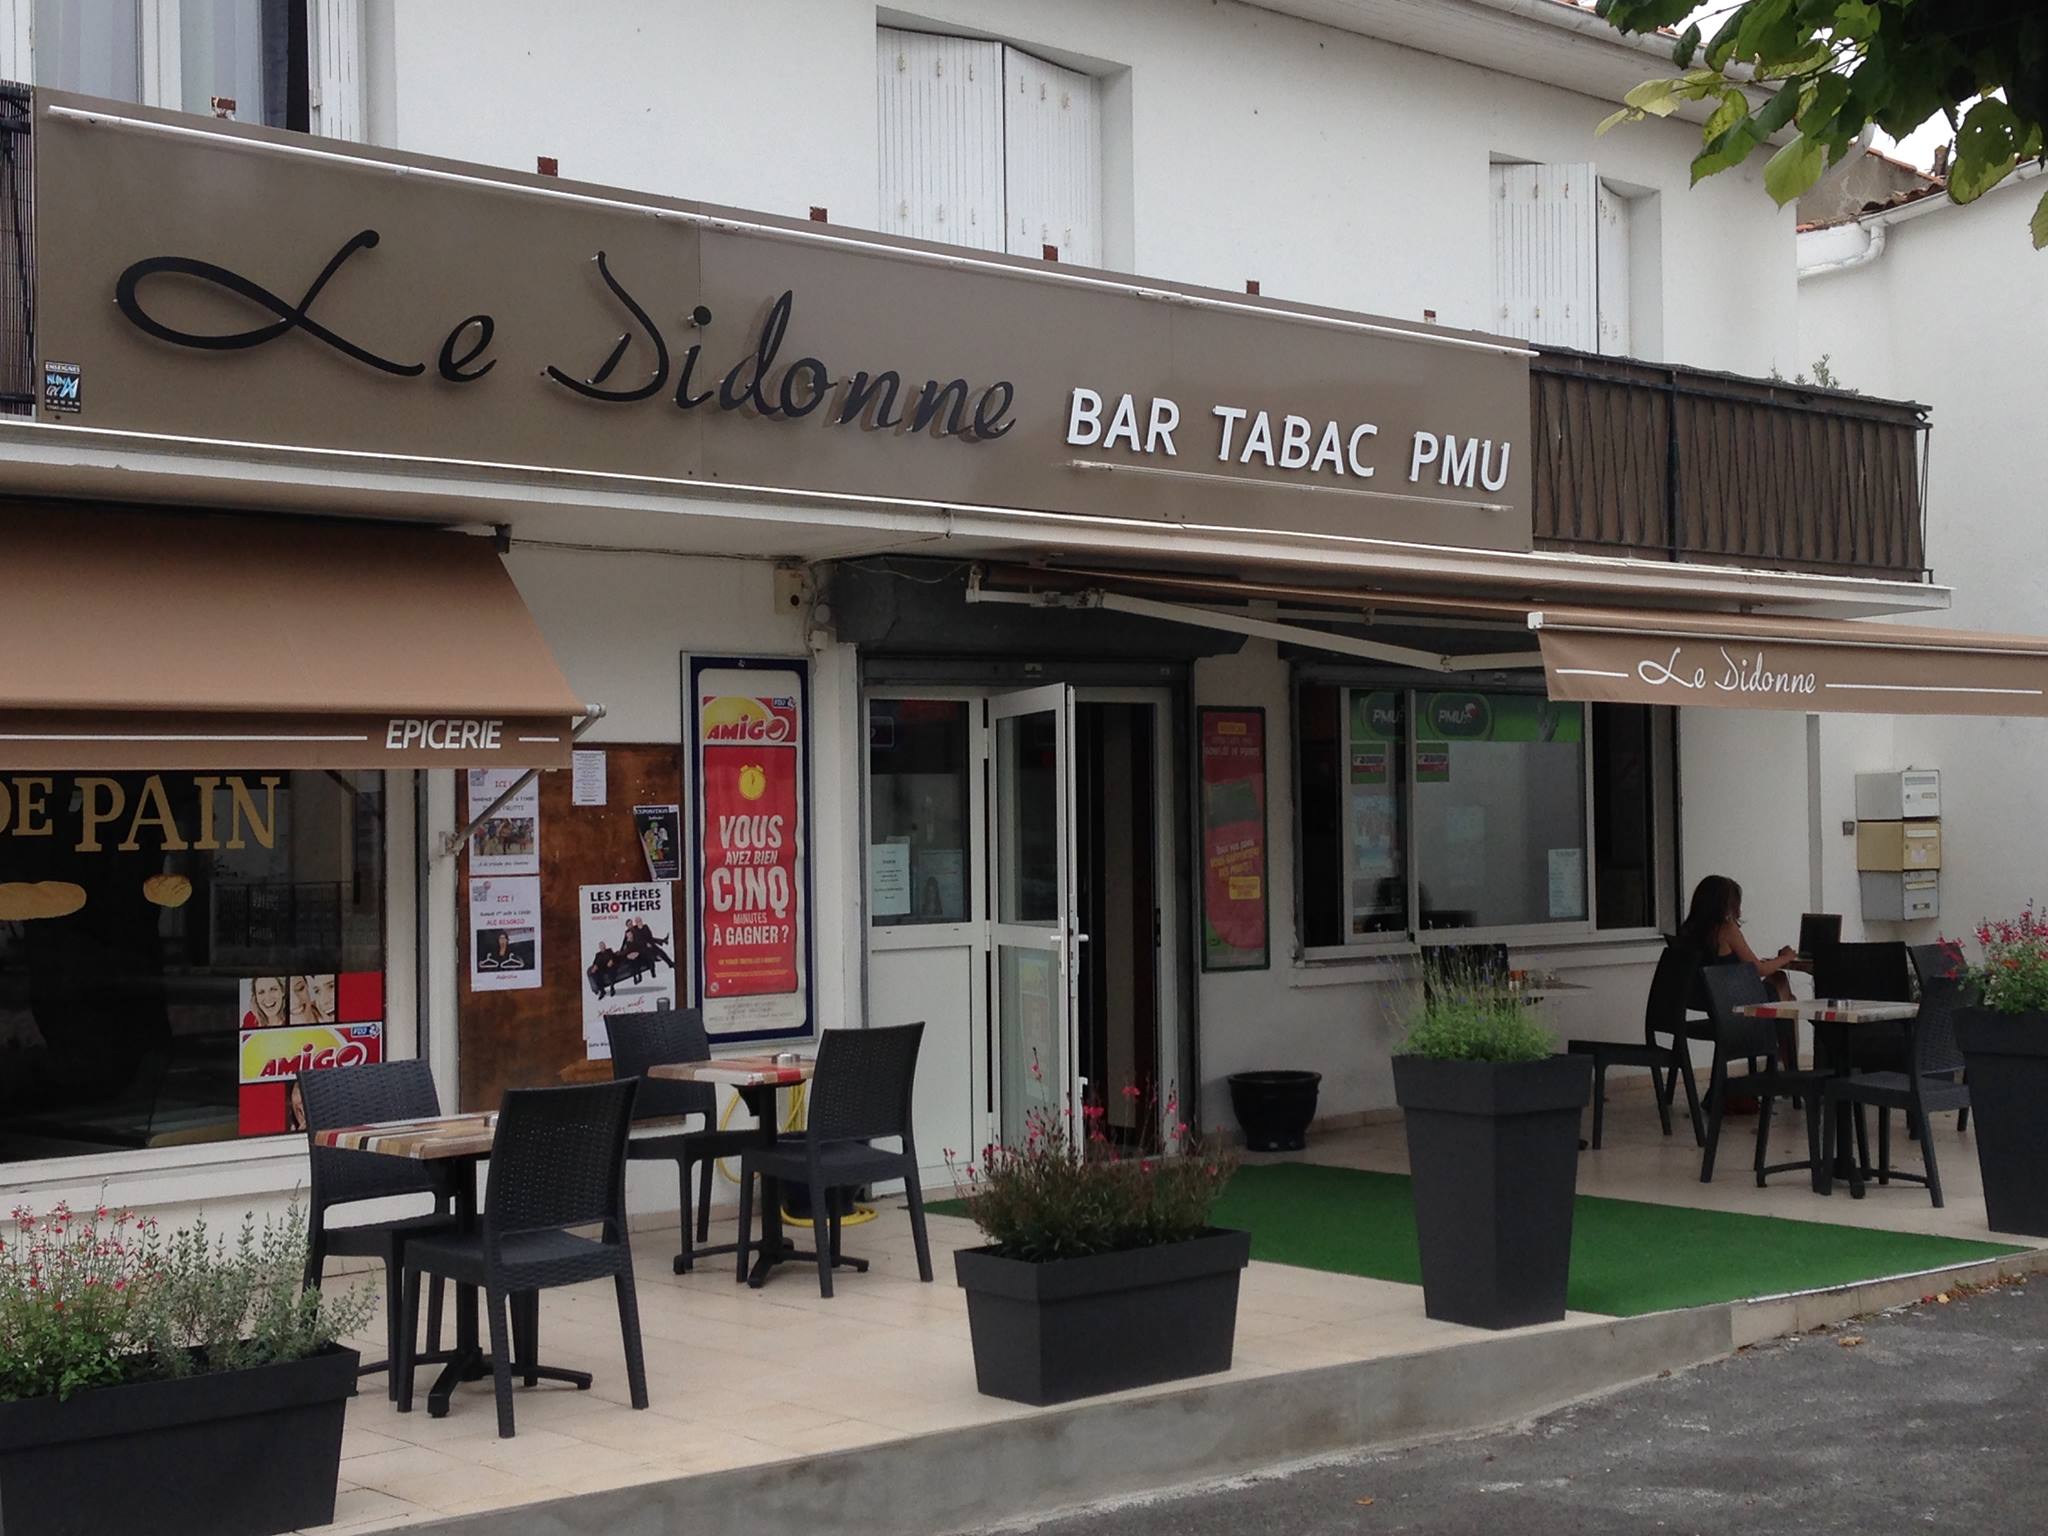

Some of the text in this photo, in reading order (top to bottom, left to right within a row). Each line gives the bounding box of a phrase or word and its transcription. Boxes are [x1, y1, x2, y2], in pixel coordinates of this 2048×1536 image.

[115, 229, 1016, 439] Le Didonne
[1067, 387, 1511, 491] BAR TABAC PMU
[1637, 646, 1817, 694] Le Didonne
[1438, 710, 1462, 724] PMU
[385, 719, 503, 749] EPICERIE
[0, 774, 281, 852] E PAIN
[719, 814, 784, 849] VOUS
[725, 850, 778, 866] AVEZ BIEN
[590, 886, 662, 902] LES FRÈRES
[591, 899, 662, 915] BROTHERS
[711, 866, 790, 918] CINQ
[733, 912, 768, 925] MINUTES
[713, 924, 790, 946] À GAGNER ?
